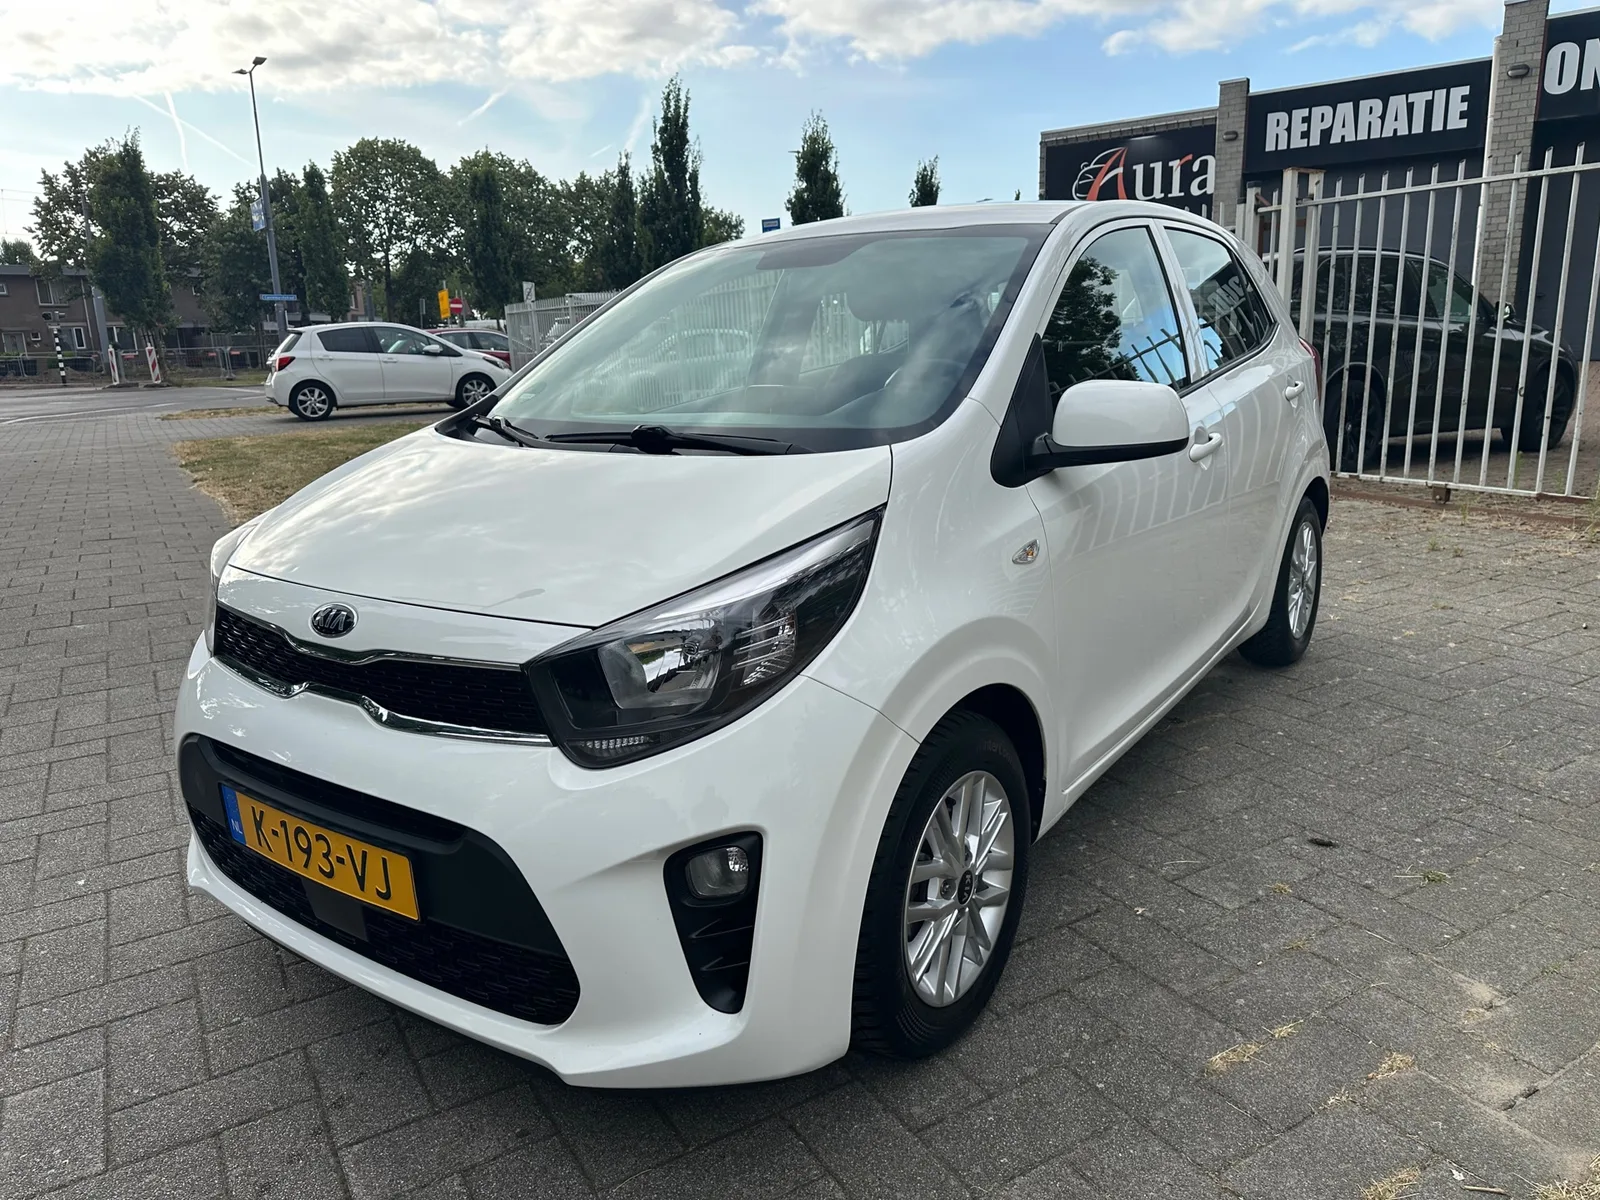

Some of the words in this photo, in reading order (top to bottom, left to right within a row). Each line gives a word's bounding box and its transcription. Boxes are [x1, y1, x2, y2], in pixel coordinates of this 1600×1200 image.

[1265, 85, 1470, 152] REPARATIE
[1086, 147, 1216, 200] Aura
[313, 608, 347, 631] KIA
[231, 818, 243, 834] NL
[251, 805, 392, 901] K-193-VJ
[962, 874, 972, 902] KIA
